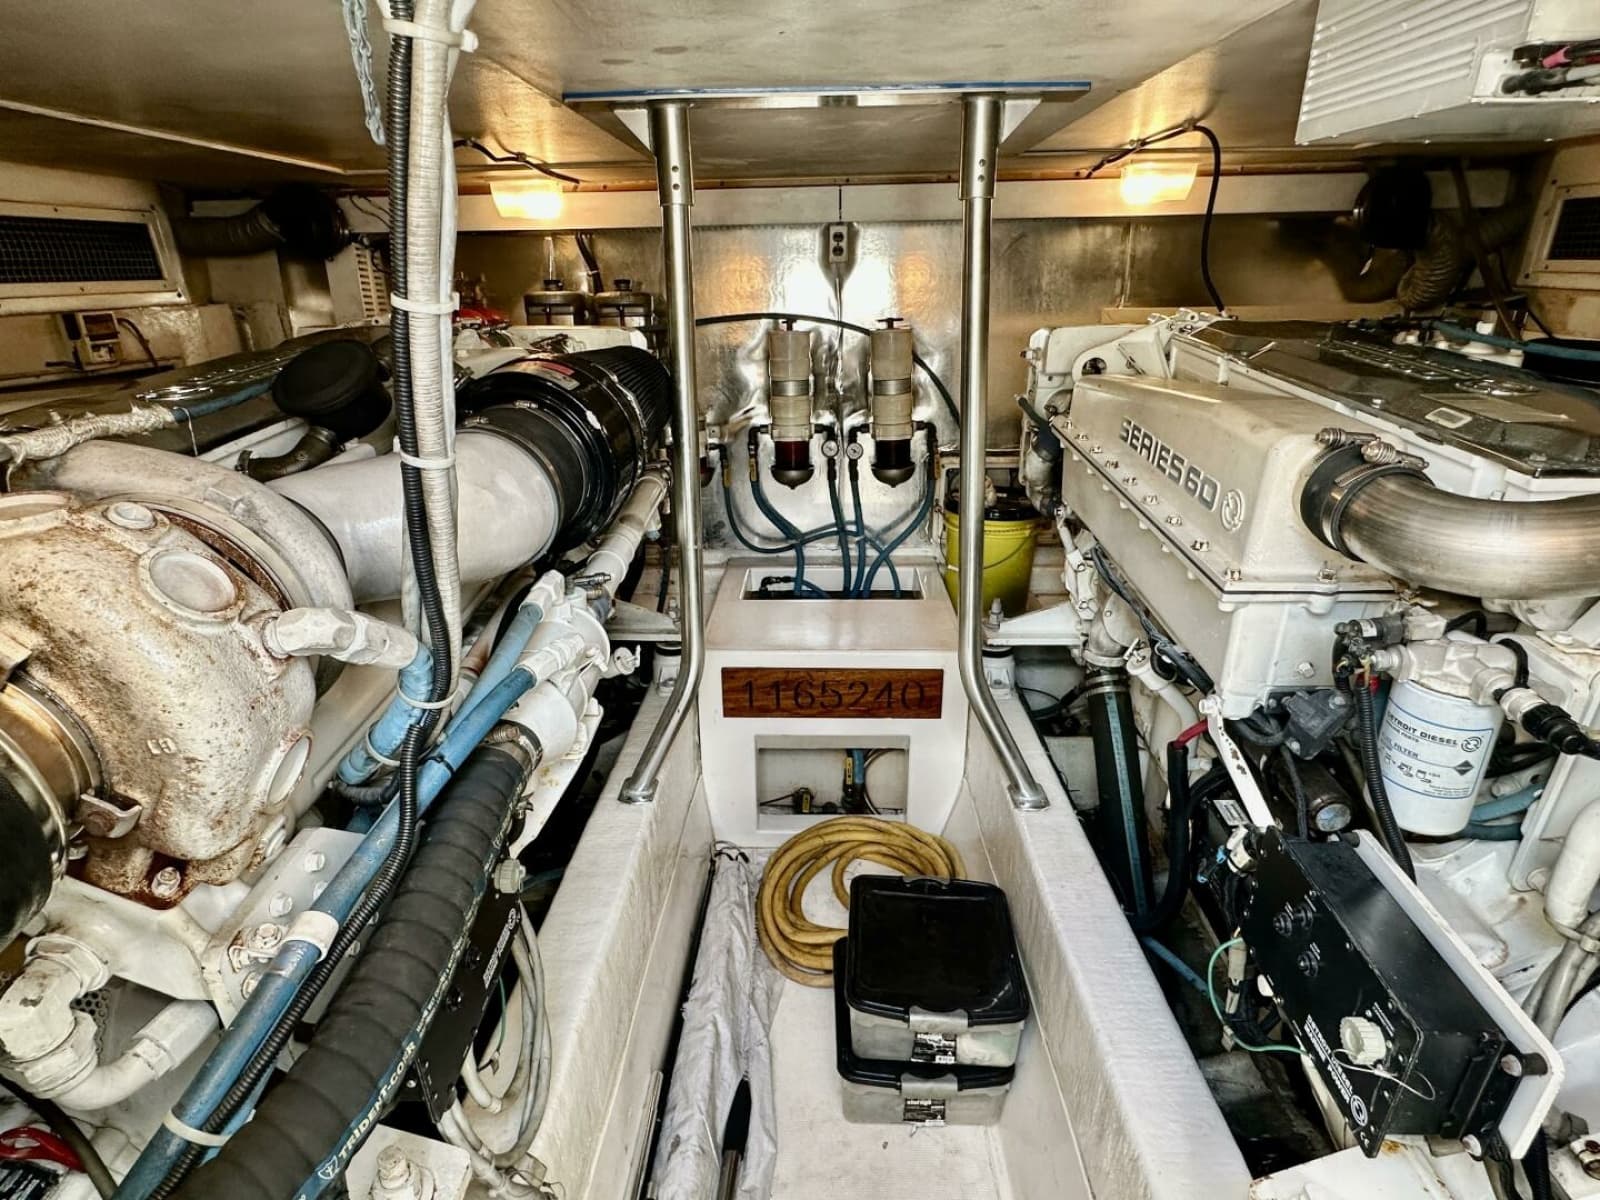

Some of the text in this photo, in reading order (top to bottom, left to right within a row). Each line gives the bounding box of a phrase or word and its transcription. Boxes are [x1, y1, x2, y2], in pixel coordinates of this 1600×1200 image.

[1119, 416, 1220, 512] SERIES 60
[743, 679, 925, 711] 1165240
[1419, 731, 1458, 746] DIESEL
